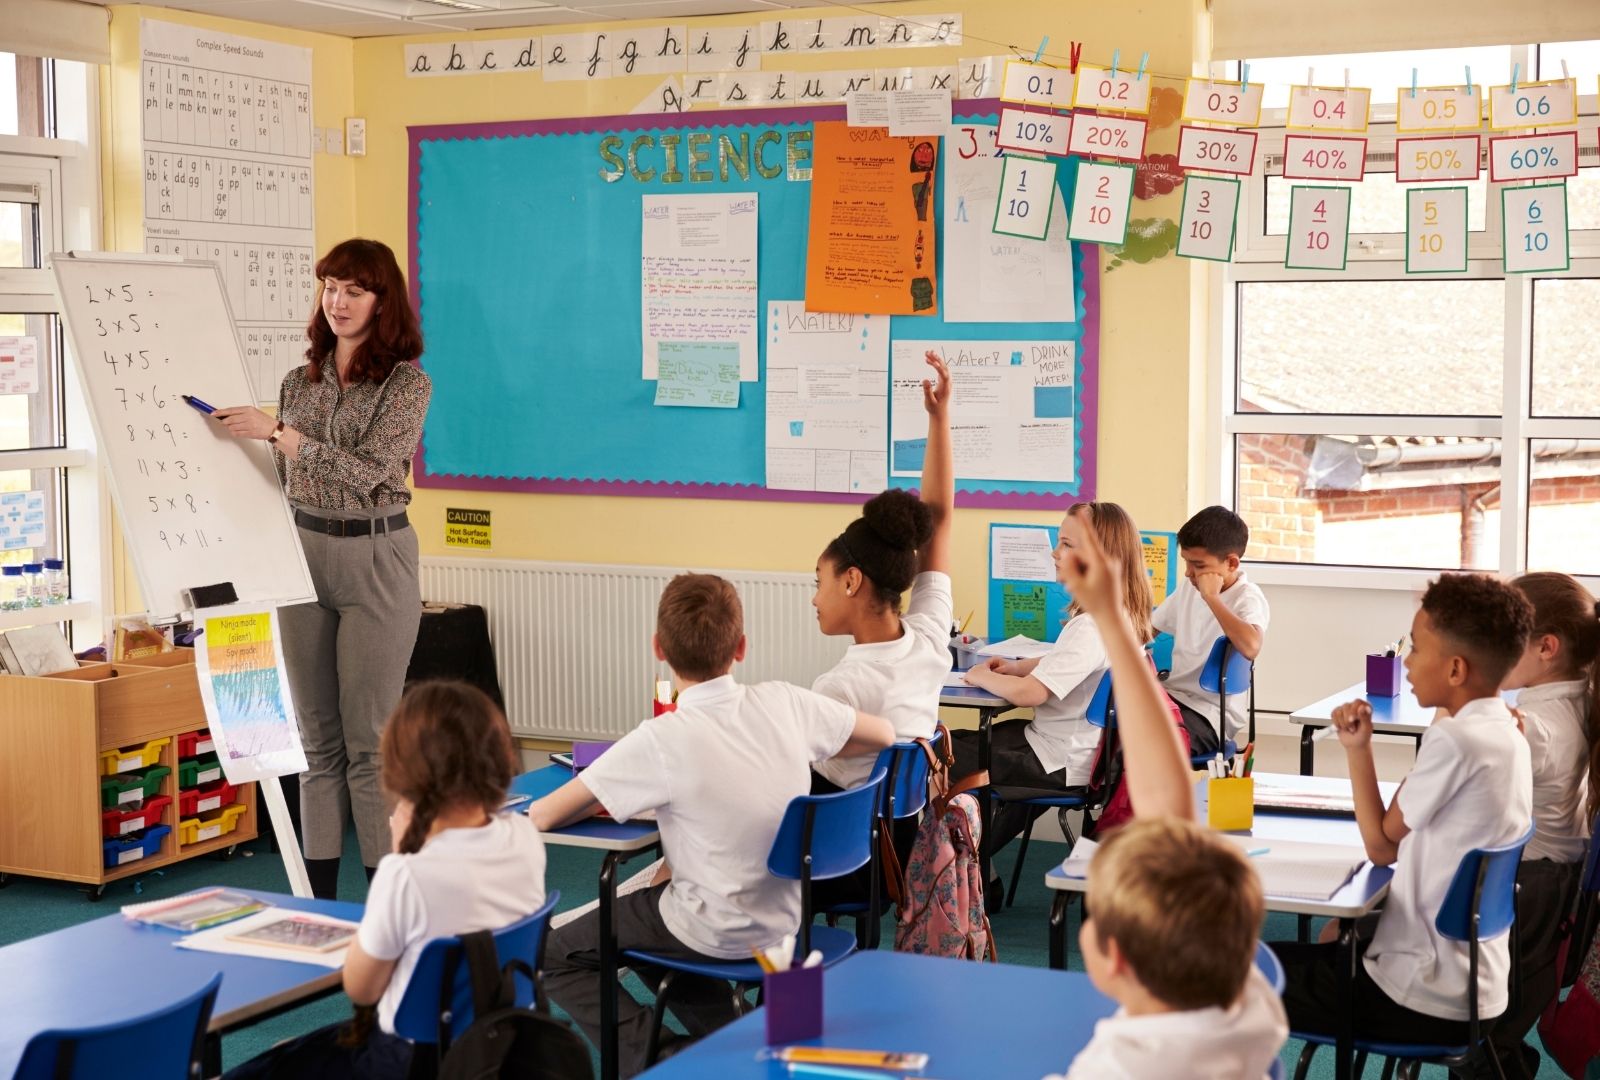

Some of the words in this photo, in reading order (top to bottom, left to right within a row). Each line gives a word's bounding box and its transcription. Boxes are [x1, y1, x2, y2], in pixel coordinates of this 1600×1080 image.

[144, 49, 171, 60] Consonant
[197, 39, 221, 51] Complex
[224, 44, 241, 56] Speed
[243, 47, 263, 58] Sounds
[412, 54, 431, 72] a
[445, 44, 465, 70] b
[480, 51, 496, 69] c
[514, 40, 536, 68] d
[548, 46, 566, 64] e
[588, 35, 605, 76] f
[620, 40, 638, 72] g
[658, 28, 681, 56] h
[697, 31, 712, 54] i
[736, 29, 750, 67] j
[769, 22, 789, 50] k
[809, 19, 824, 49] l
[845, 26, 875, 46] m
[888, 24, 911, 43] n
[691, 79, 712, 98] r
[727, 82, 747, 101] s
[770, 74, 786, 99] t
[804, 79, 823, 97] u
[966, 64, 985, 97] y
[1028, 76, 1053, 95] 0.1
[1100, 81, 1129, 100] 0.2
[150, 82, 155, 91] ff
[167, 83, 172, 94] ll
[179, 89, 192, 97] mm
[197, 91, 206, 99] nn
[273, 100, 278, 109] ti
[298, 105, 307, 113] nk
[271, 83, 278, 95] sh
[285, 87, 292, 98] th
[298, 91, 307, 102] ng
[147, 98, 157, 109] ph
[166, 98, 173, 109] le
[180, 101, 192, 112] mb
[197, 102, 207, 113] kn
[228, 110, 236, 118] se
[273, 114, 279, 123] ci
[1208, 93, 1238, 113] 0.3
[1313, 100, 1346, 119] 0.4
[1423, 99, 1456, 119] 0.5
[1516, 96, 1550, 116] 0.6
[1016, 122, 1053, 143] 10%
[1087, 127, 1129, 148] 20%
[598, 131, 813, 183] SCIENCE
[1196, 141, 1237, 162] 30%
[1302, 150, 1347, 169] 40%
[1416, 150, 1461, 170] 50%
[1510, 147, 1558, 169] 60%
[147, 171, 157, 181] bb
[175, 173, 185, 183] dd
[189, 176, 199, 187] gg
[230, 180, 239, 190] pp
[257, 181, 262, 190] tt
[266, 182, 277, 191] wh
[300, 186, 309, 194] tch
[242, 166, 251, 176] qu
[300, 170, 308, 180] ch
[1019, 170, 1028, 187] 1
[1098, 176, 1110, 194] 2
[162, 187, 170, 197] ck
[217, 193, 226, 203] ge
[1199, 191, 1210, 208] 3
[162, 203, 170, 213] ch
[215, 208, 227, 219] dge
[1008, 199, 1029, 217] 10
[1089, 206, 1111, 224] 10
[1314, 200, 1326, 218] 4
[1425, 202, 1437, 220] 5
[1528, 200, 1541, 219] 6
[1190, 221, 1212, 239] 10
[1307, 231, 1329, 250] 10
[1420, 234, 1442, 252] 10
[1524, 233, 1548, 251] 10
[250, 251, 258, 259] ay
[283, 251, 294, 262] igh
[250, 278, 257, 287] ai
[268, 279, 276, 287] ea
[287, 279, 292, 288] ie
[302, 280, 310, 288] oa
[86, 285, 100, 303] 2
[123, 284, 134, 301] 5
[96, 318, 108, 336] 3
[130, 314, 141, 332] 5
[263, 334, 272, 344] oy
[290, 334, 301, 342] ear
[104, 351, 118, 375] 4
[139, 351, 150, 369] 5
[1032, 345, 1069, 365] DRINK
[1039, 362, 1064, 373] MORE
[115, 388, 127, 410] 7
[153, 385, 165, 408] 6
[127, 425, 135, 441] 8
[164, 424, 176, 446] 9
[175, 461, 188, 479] 3
[149, 496, 159, 512] 5
[185, 494, 196, 513] 8
[448, 512, 489, 522] CAUTION
[160, 531, 171, 550] 9
[458, 536, 468, 544] Not
[463, 529, 487, 537] Surface
[220, 620, 238, 631] Ninja
[239, 617, 256, 626] mode
[229, 632, 251, 643] (silent)
